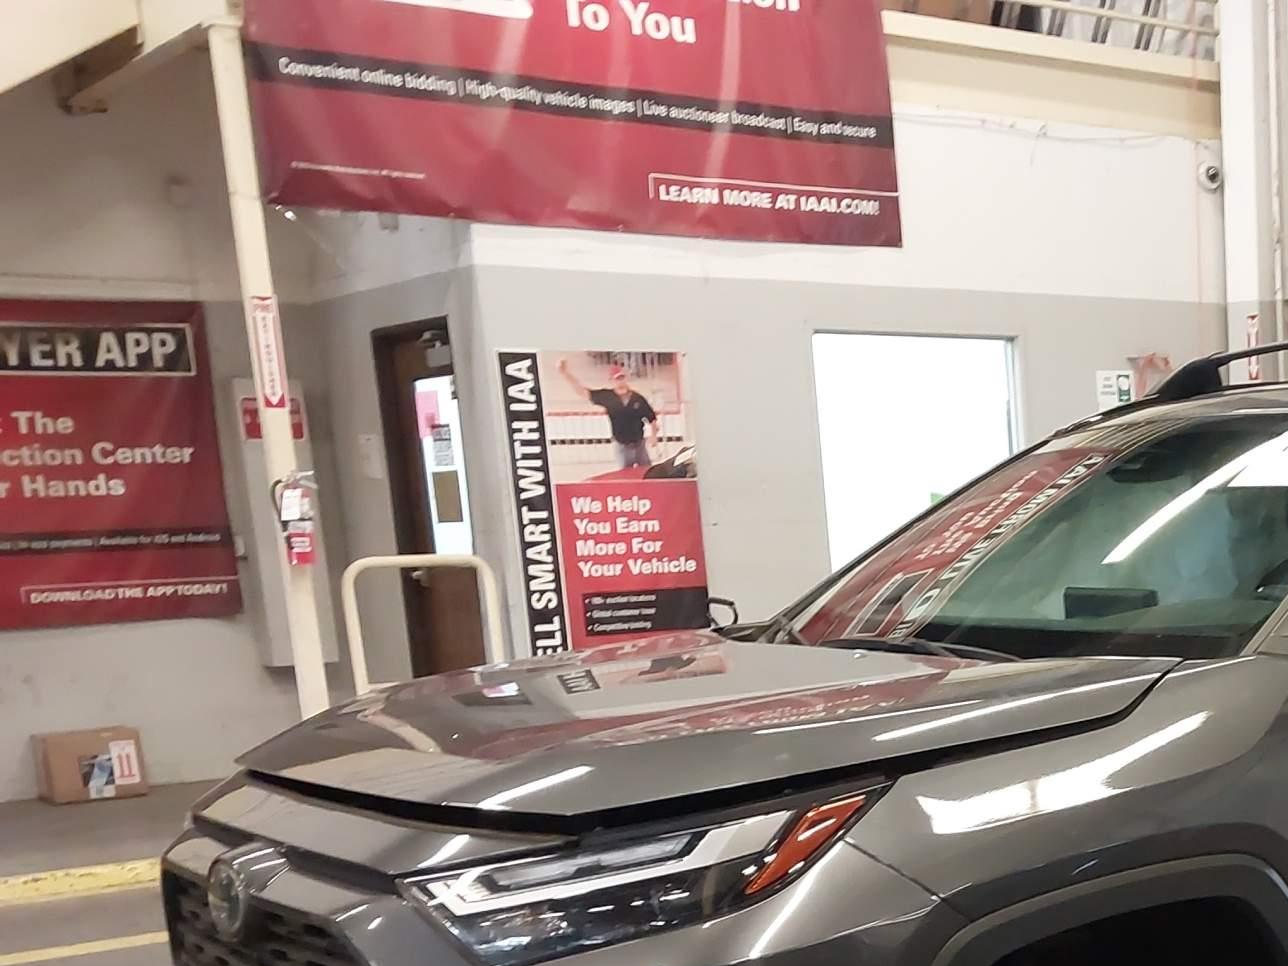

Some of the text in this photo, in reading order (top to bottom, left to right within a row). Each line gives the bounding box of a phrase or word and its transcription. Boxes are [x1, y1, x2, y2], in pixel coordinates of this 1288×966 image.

[564, 0, 697, 44] To You
[278, 56, 361, 82] Convenient
[361, 68, 404, 88] online
[405, 72, 456, 96] bidding
[466, 79, 543, 105] High-quality
[543, 89, 588, 111] vehicle
[588, 93, 635, 114] images
[643, 99, 668, 118] Live
[669, 105, 730, 125] auctioneer
[731, 108, 786, 131] broadcast
[793, 117, 819, 136] Easy
[820, 121, 841, 136] and
[841, 124, 877, 139] secure
[658, 183, 719, 205] LEARN
[722, 189, 773, 209] MORE
[775, 194, 798, 211] AT
[95, 331, 177, 368] APP
[504, 357, 538, 412] IAA
[10, 410, 75, 435] The
[91, 441, 195, 465] Center
[511, 419, 546, 500] WITH
[21, 473, 127, 498] Hands
[571, 496, 651, 516] We Help
[574, 517, 660, 535] You Earn
[521, 506, 557, 611] SMART
[576, 537, 664, 557] More For
[577, 555, 697, 578] Your Vehicle
[30, 582, 229, 604] DOWNLOAD THE APP TODAY!
